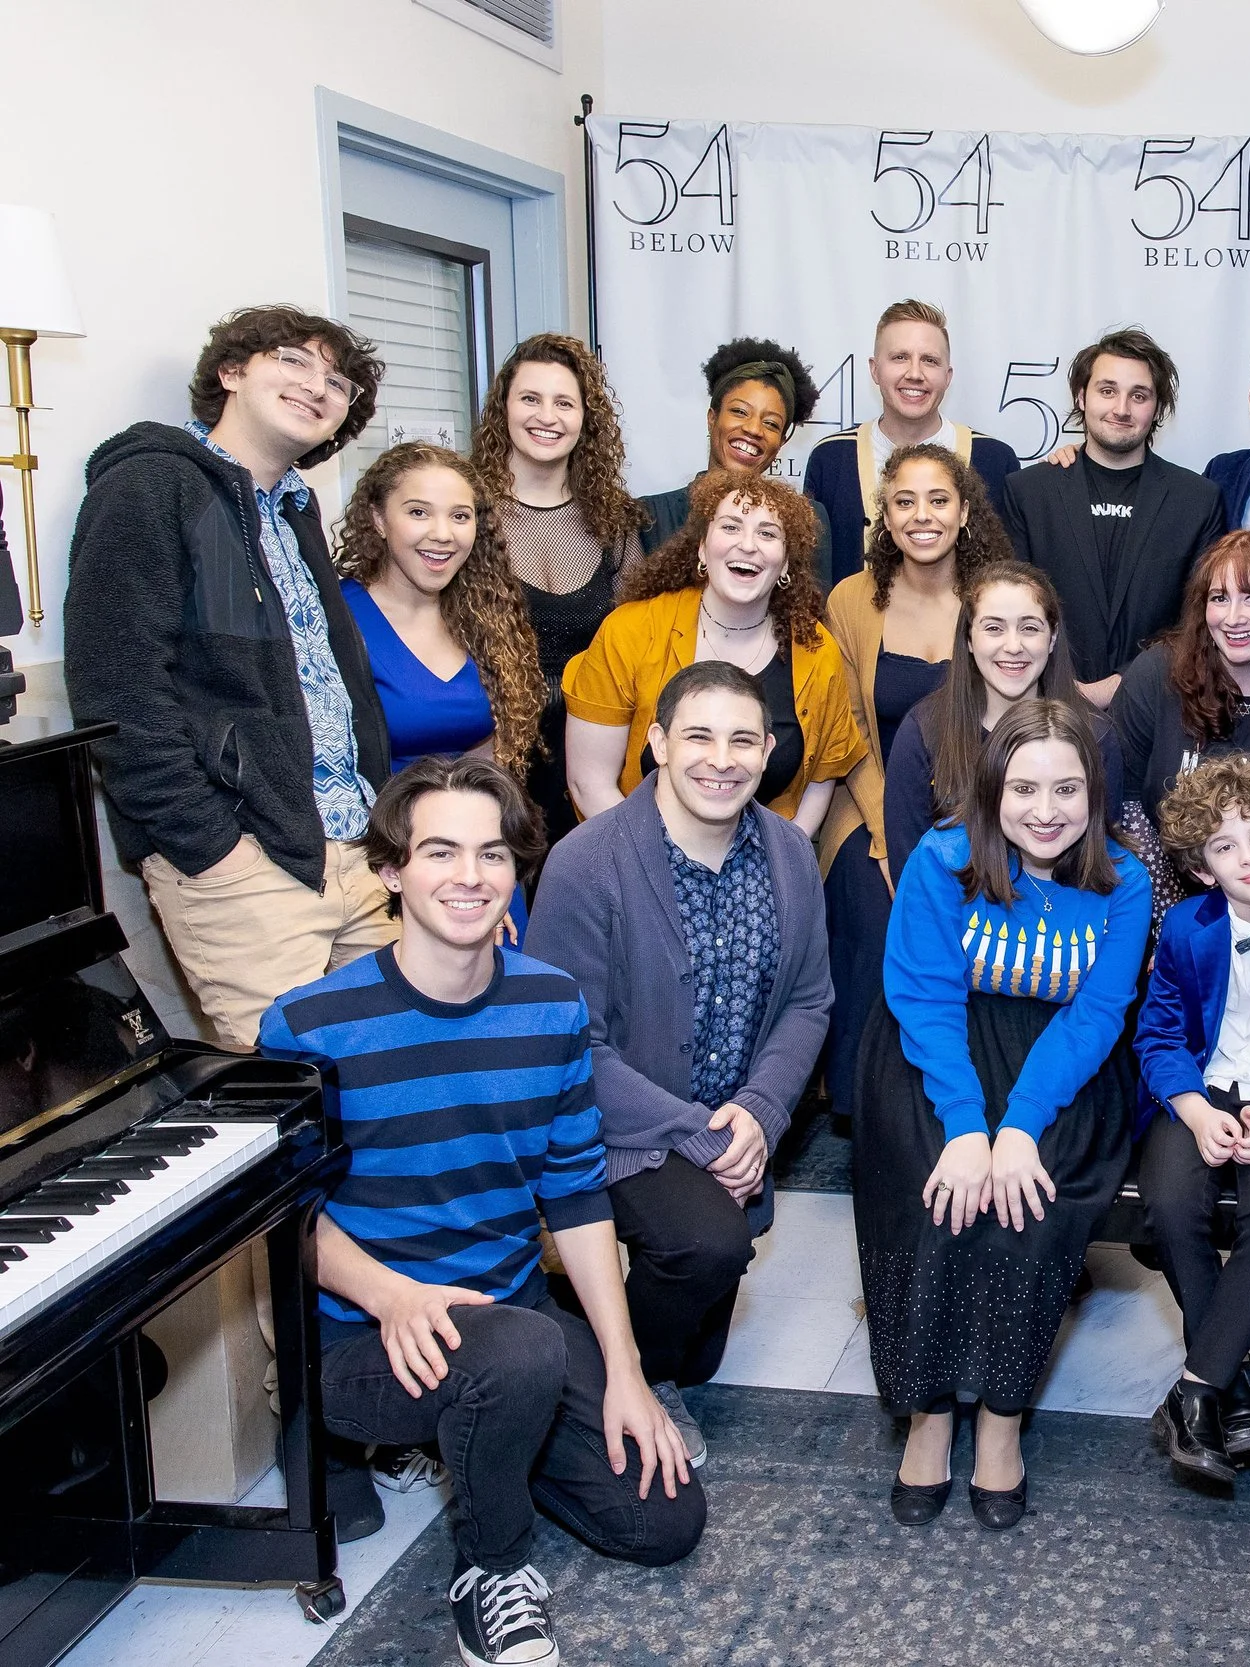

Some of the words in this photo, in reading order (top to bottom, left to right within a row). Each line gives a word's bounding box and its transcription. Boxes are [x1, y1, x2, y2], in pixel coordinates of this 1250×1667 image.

[613, 121, 737, 226] 54
[871, 130, 1004, 234] 54
[629, 231, 735, 253] BELOW
[884, 240, 990, 262] BELOW
[1144, 247, 1250, 267] BELOW
[999, 357, 1085, 461] 5
